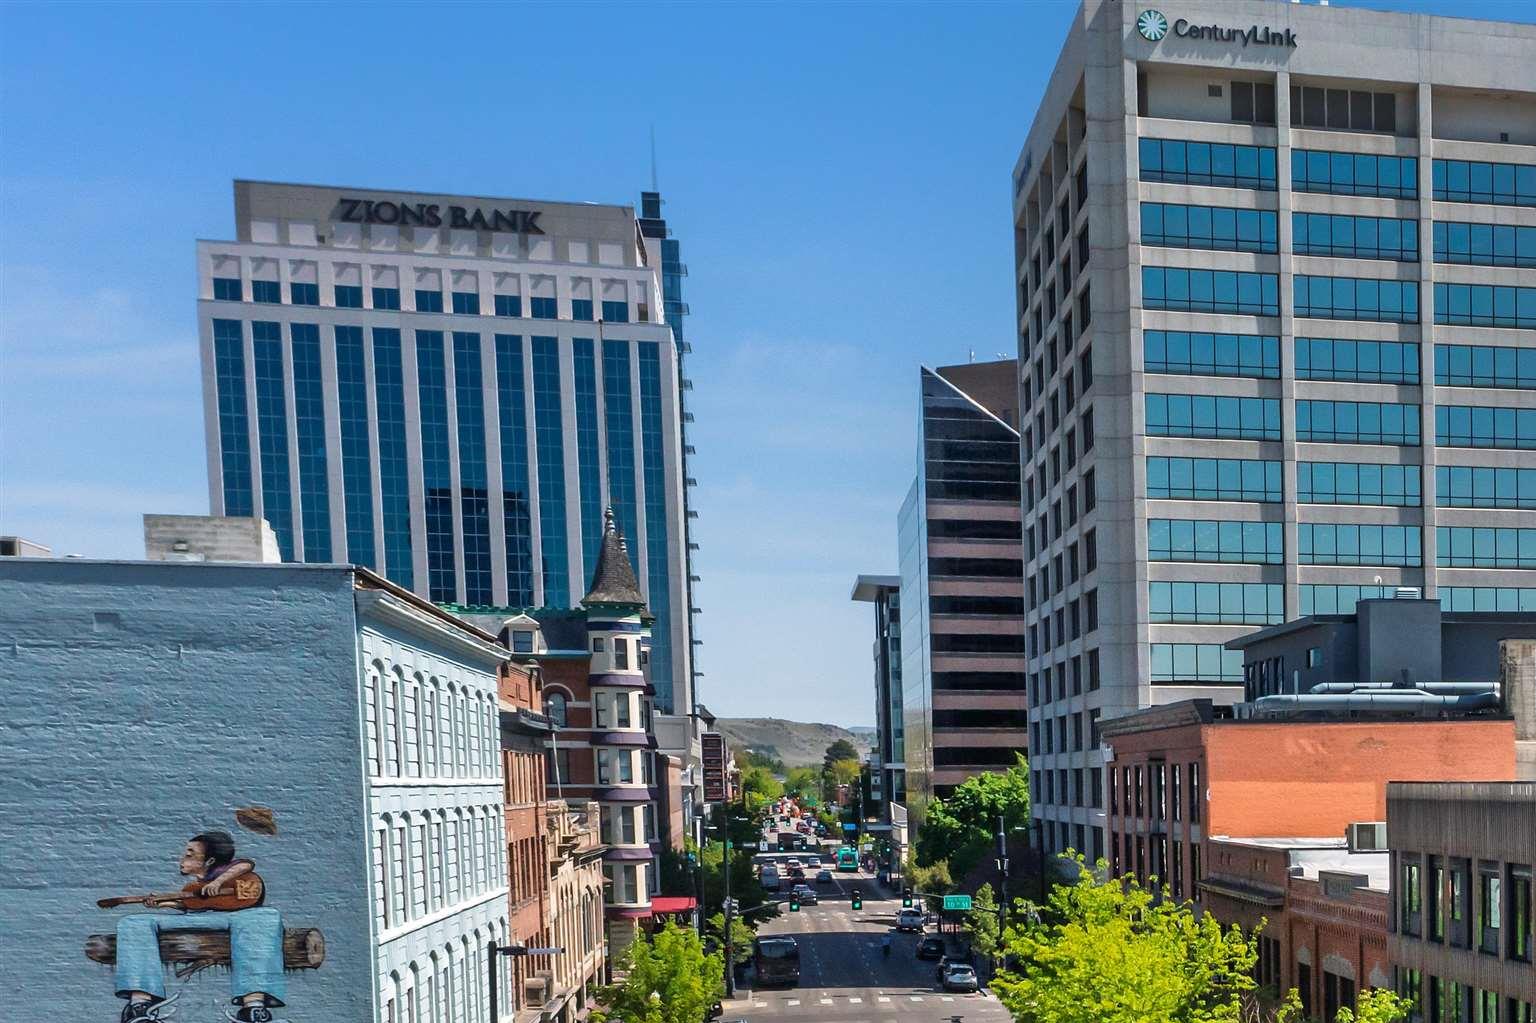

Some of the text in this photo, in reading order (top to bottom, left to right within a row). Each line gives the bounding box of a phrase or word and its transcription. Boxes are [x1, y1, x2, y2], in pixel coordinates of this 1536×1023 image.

[1175, 18, 1297, 48] CenturyLink
[339, 198, 545, 235] ZIONS BANK
